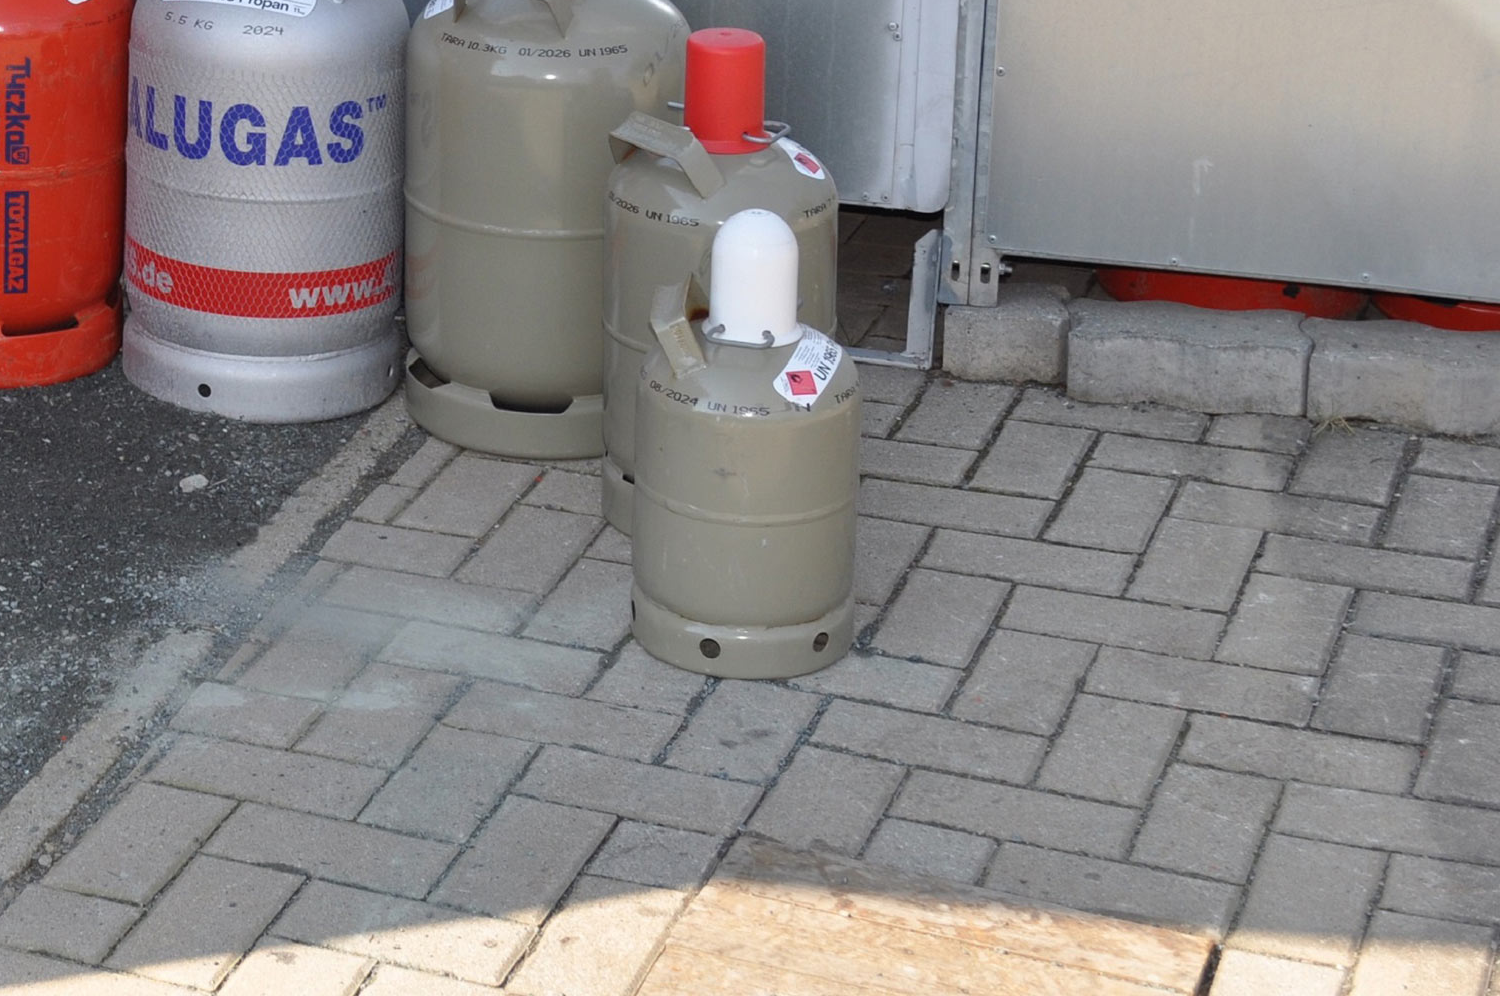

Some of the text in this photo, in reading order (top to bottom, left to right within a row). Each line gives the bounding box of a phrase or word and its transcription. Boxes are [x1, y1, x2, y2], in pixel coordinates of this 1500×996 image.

[164, 11, 284, 36] 5.5 KG 2024
[440, 32, 628, 58] TARA 10.3KG 01/2026 UN 1965
[4, 56, 32, 149] Tyczka
[645, 210, 662, 221] UN
[667, 214, 701, 227] 1965
[5, 193, 27, 292] TOTALGAZ
[289, 270, 387, 309] www.
[813, 361, 832, 381] UN
[649, 379, 699, 407] 08/2024
[707, 401, 727, 413] UN
